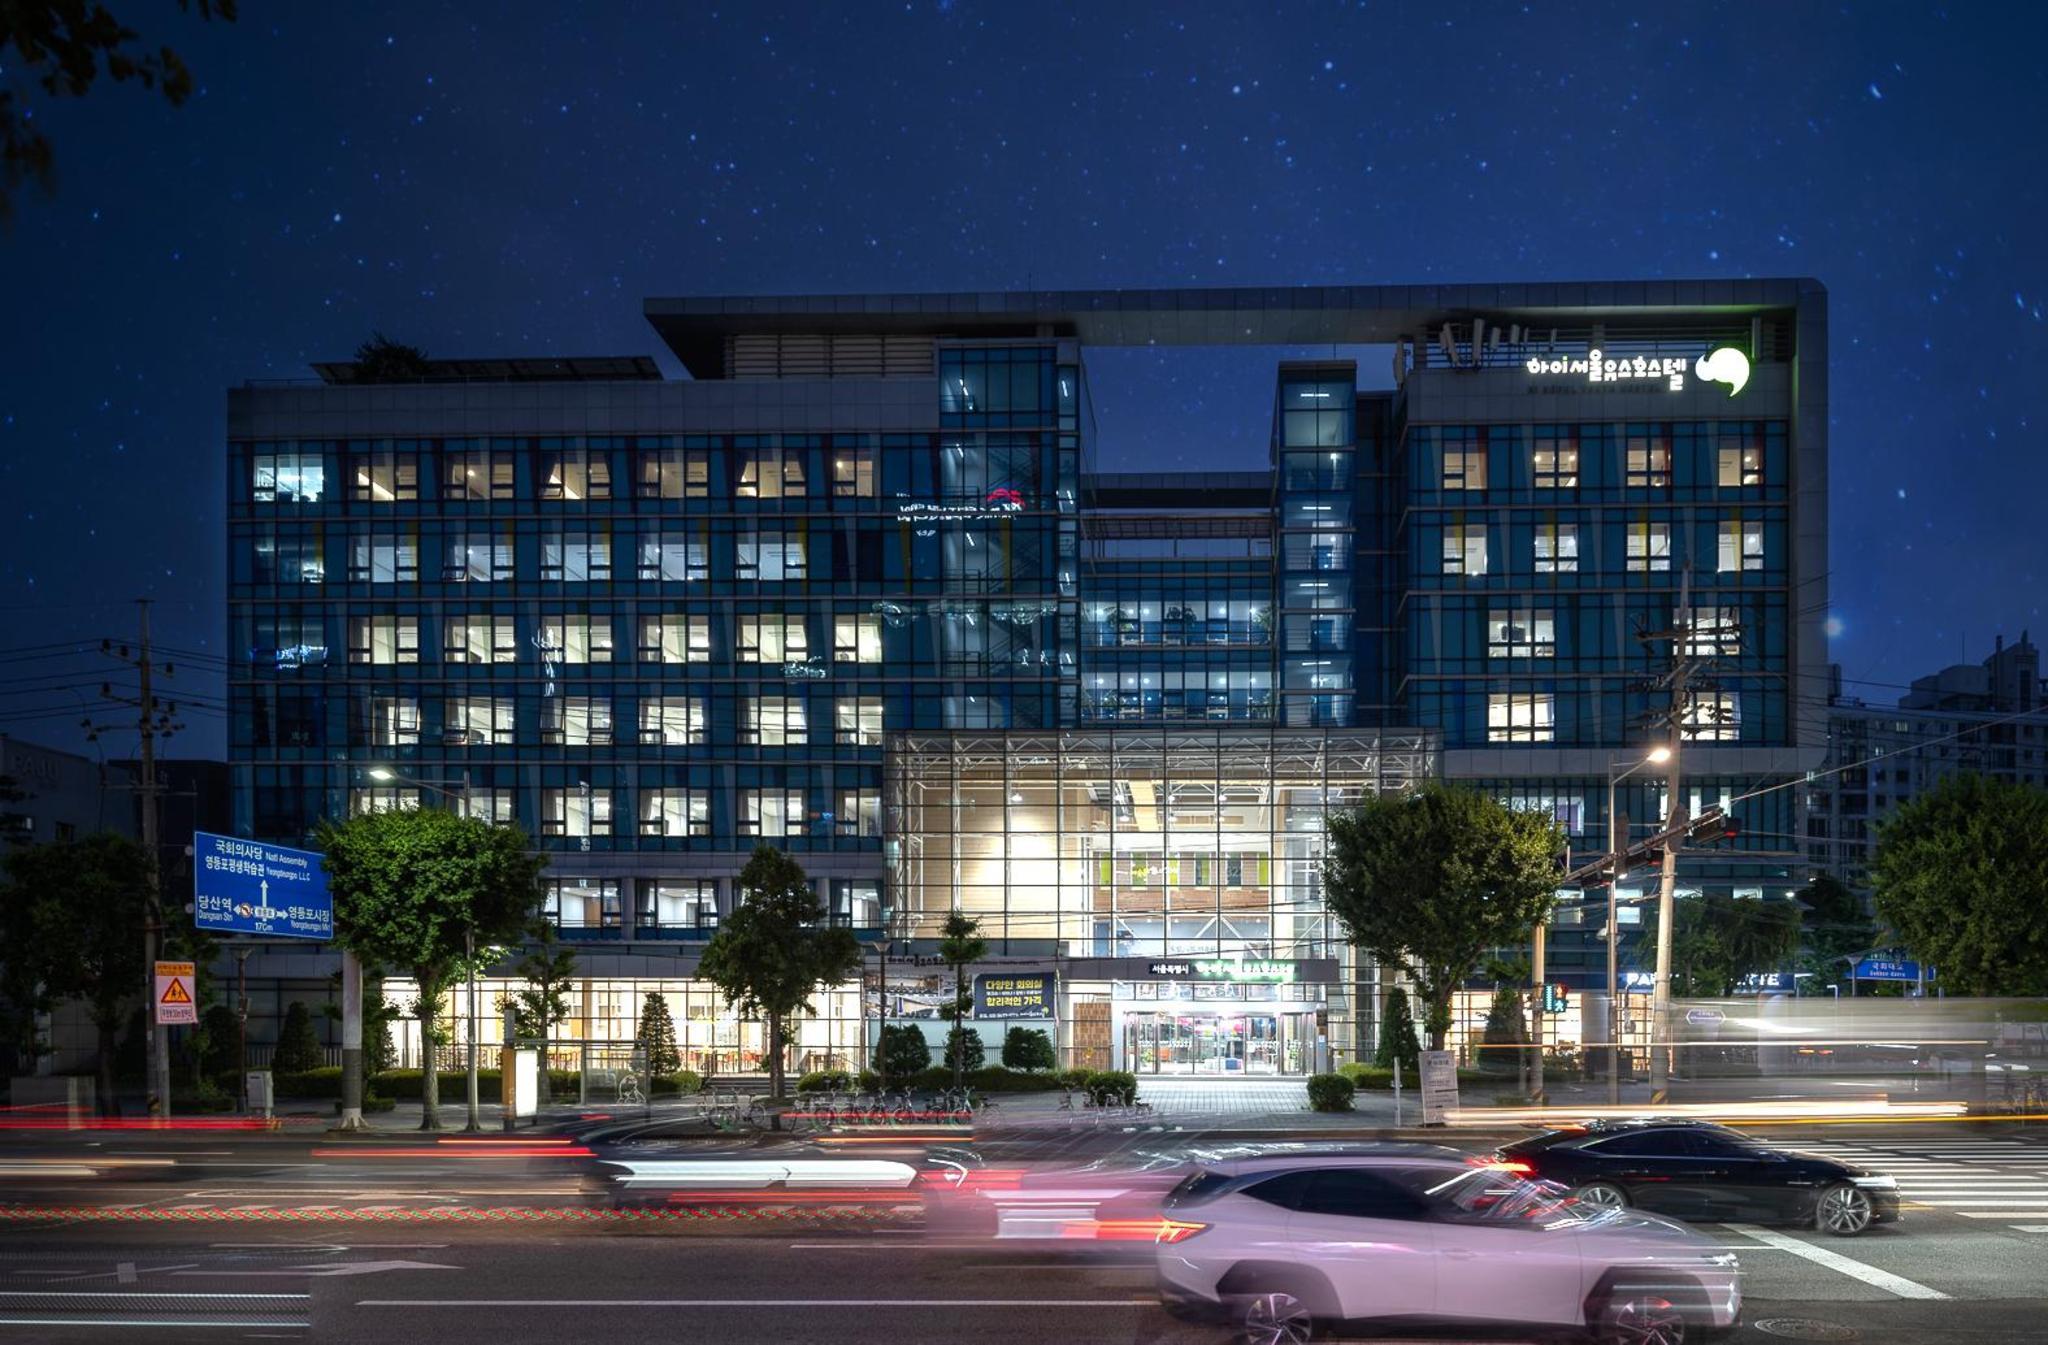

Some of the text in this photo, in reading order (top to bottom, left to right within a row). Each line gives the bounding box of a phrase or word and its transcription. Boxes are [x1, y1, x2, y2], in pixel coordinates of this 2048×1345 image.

[1526, 349, 1687, 391] 하이서울유스호스텔
[215, 839, 263, 860] 국회의사당
[205, 855, 265, 877] 영등포평생학습관
[198, 895, 232, 912] 당산역
[288, 906, 330, 923] 영등포시장
[985, 980, 1013, 990] 다양한
[986, 995, 1042, 1007] 합리적인 가격
